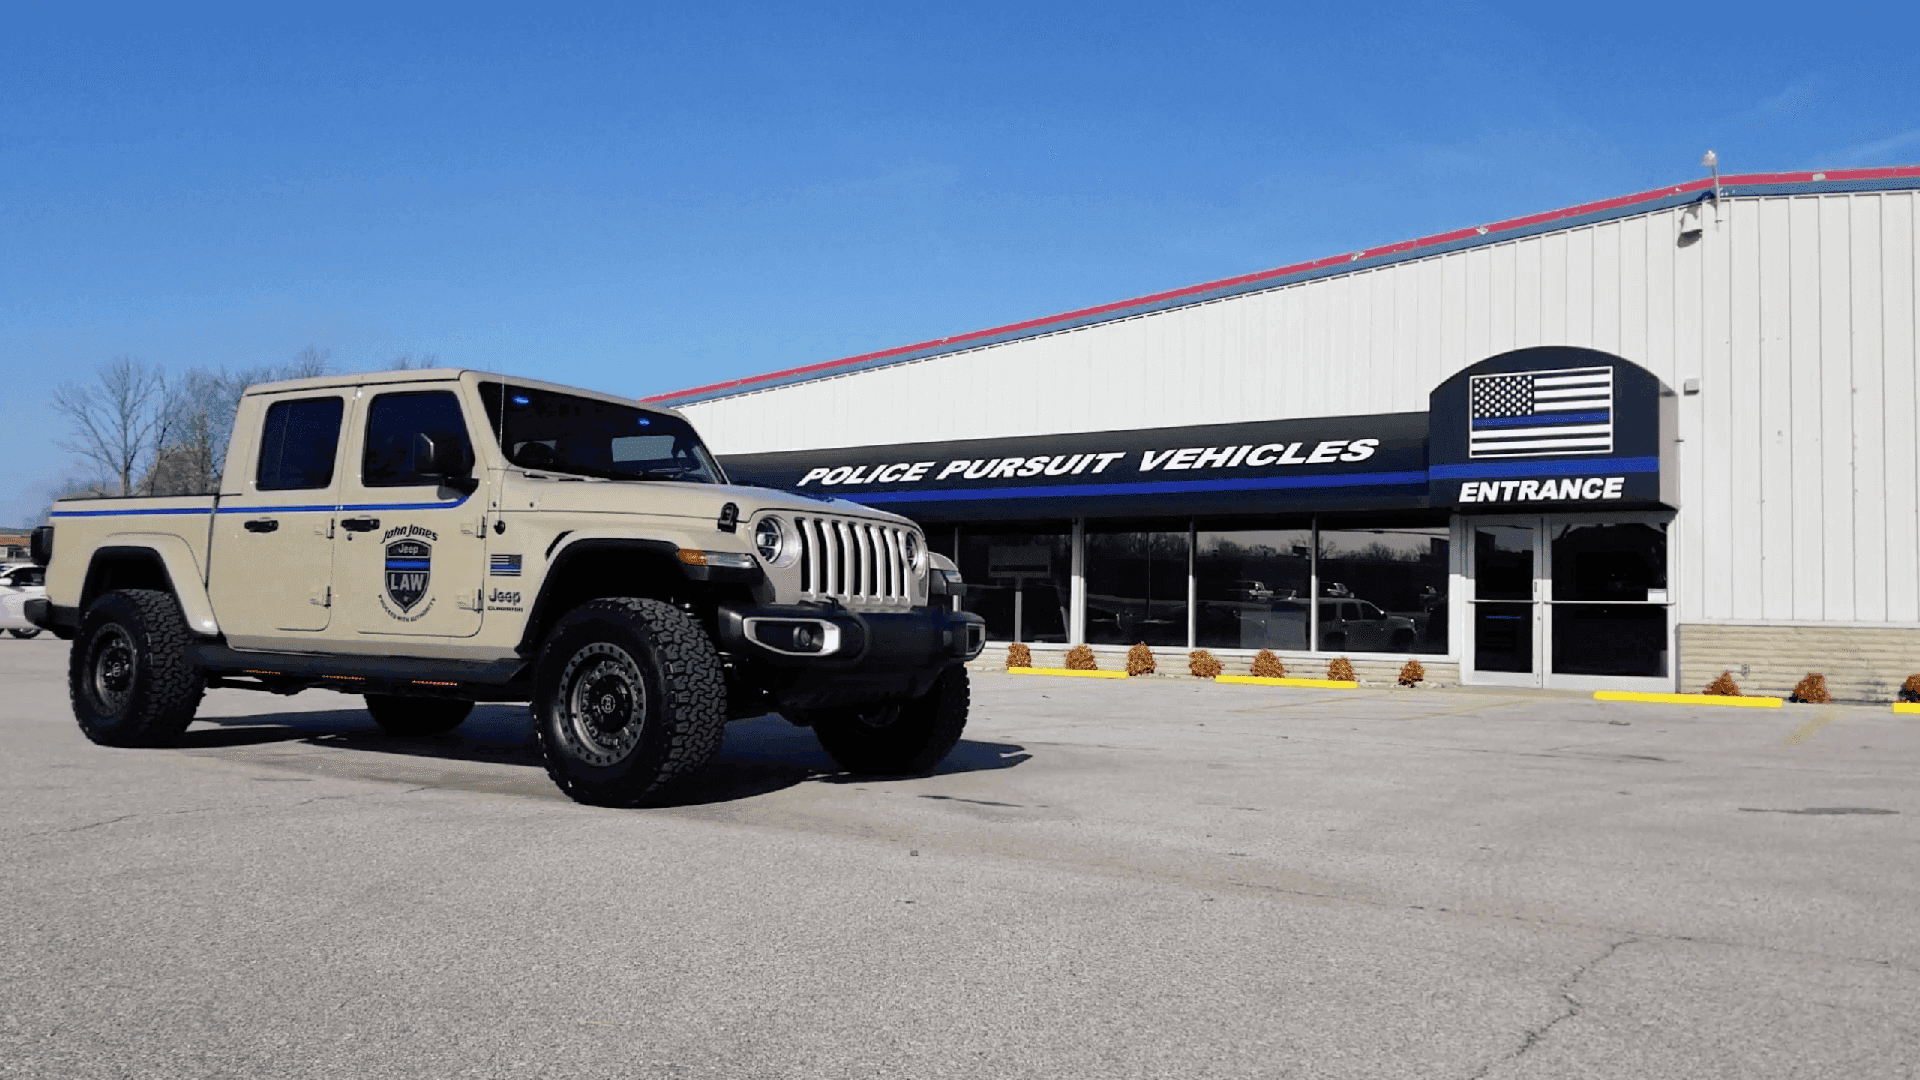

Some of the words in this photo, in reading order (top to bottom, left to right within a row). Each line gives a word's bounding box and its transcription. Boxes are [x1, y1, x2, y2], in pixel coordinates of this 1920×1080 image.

[797, 462, 936, 486] POLICE
[936, 452, 1126, 479] PURSUIT
[1139, 439, 1379, 471] VEHICLES
[1459, 477, 1624, 502] ENTRANCE
[380, 526, 407, 544] John
[406, 523, 438, 541] Jones
[399, 544, 419, 556] Jeep
[390, 573, 425, 591] LAW
[488, 588, 521, 606] Jeep
